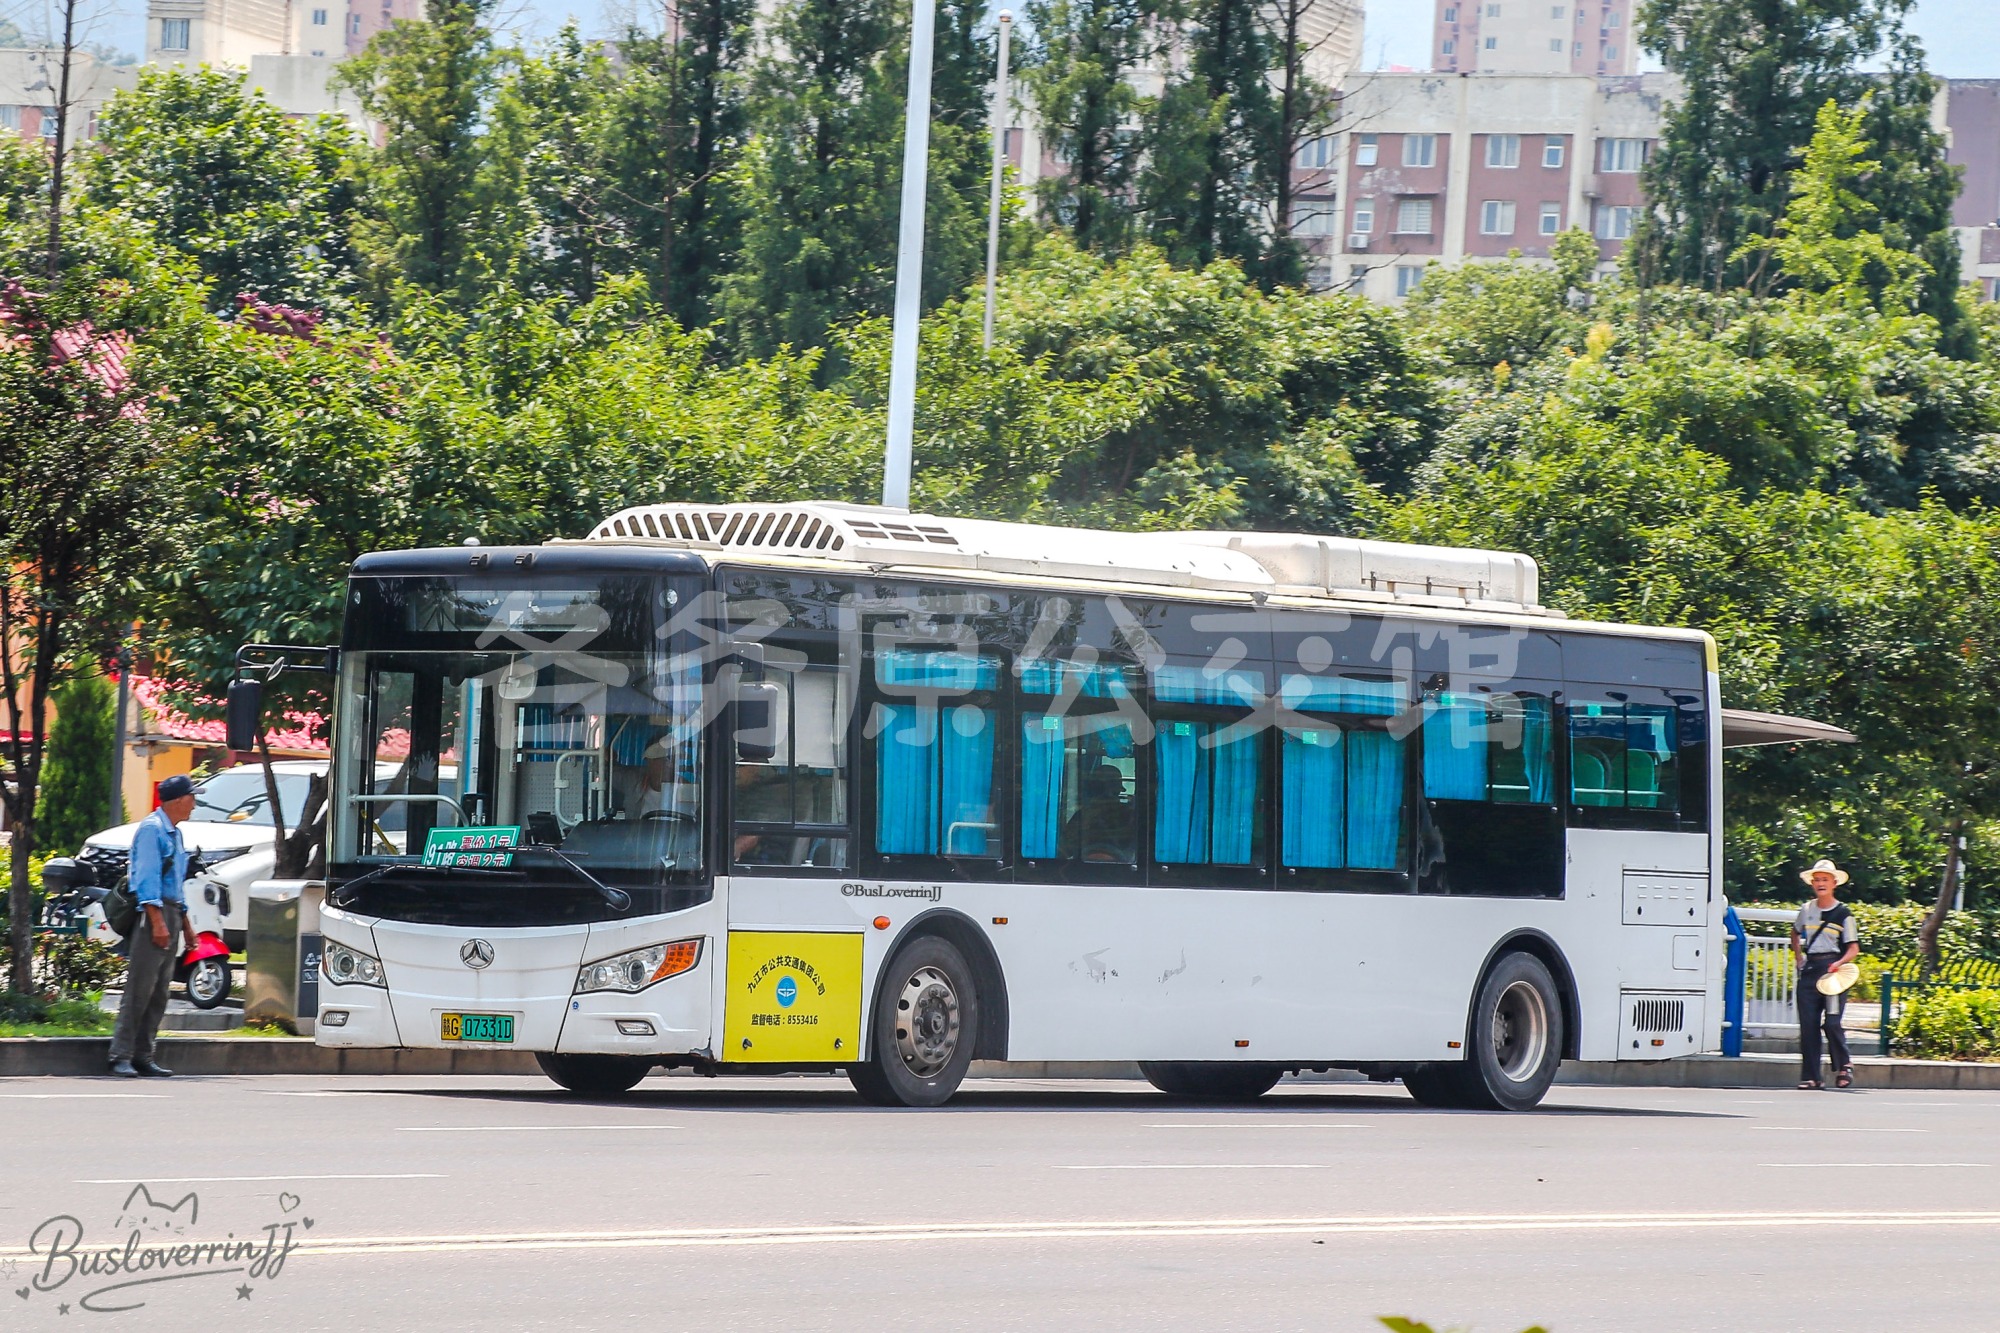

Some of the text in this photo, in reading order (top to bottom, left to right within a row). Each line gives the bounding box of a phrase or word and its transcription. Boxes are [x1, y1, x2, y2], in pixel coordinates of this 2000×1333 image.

[747, 955, 826, 996] 九江市公共交通集团公司
